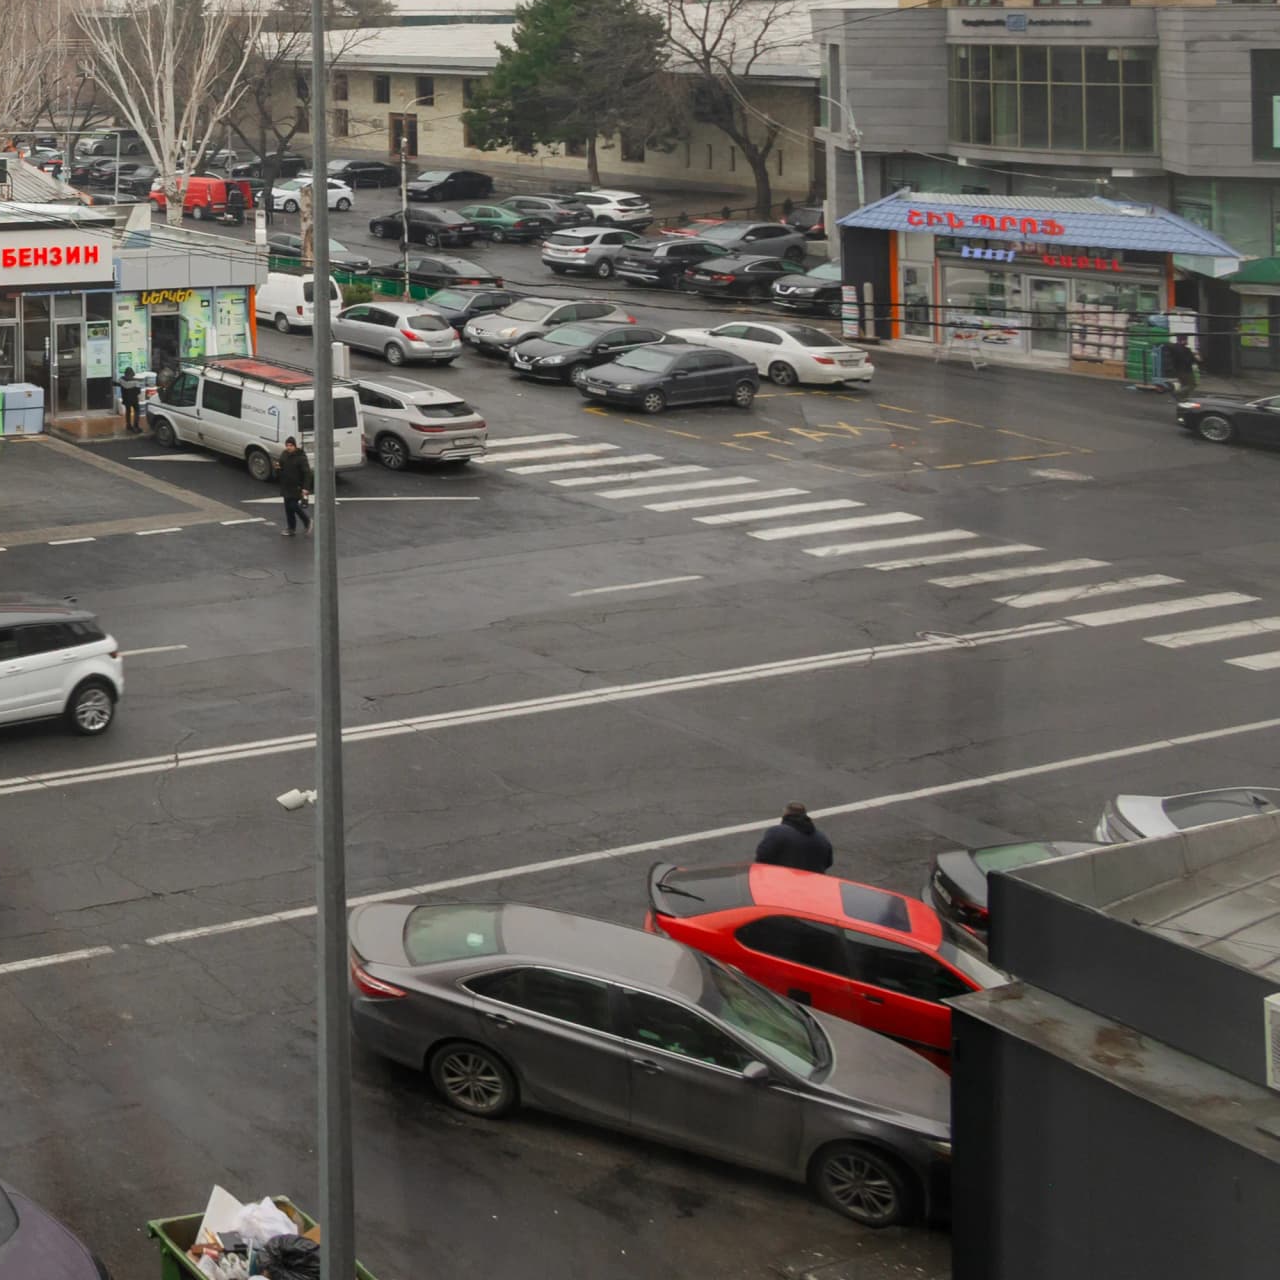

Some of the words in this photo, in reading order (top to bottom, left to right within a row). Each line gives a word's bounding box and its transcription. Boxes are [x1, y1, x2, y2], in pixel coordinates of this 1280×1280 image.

[908, 210, 965, 229] ՇԻՆ
[1, 245, 99, 268] БЕНЗИН
[141, 289, 195, 305] ՆԵՐԿԵՐ
